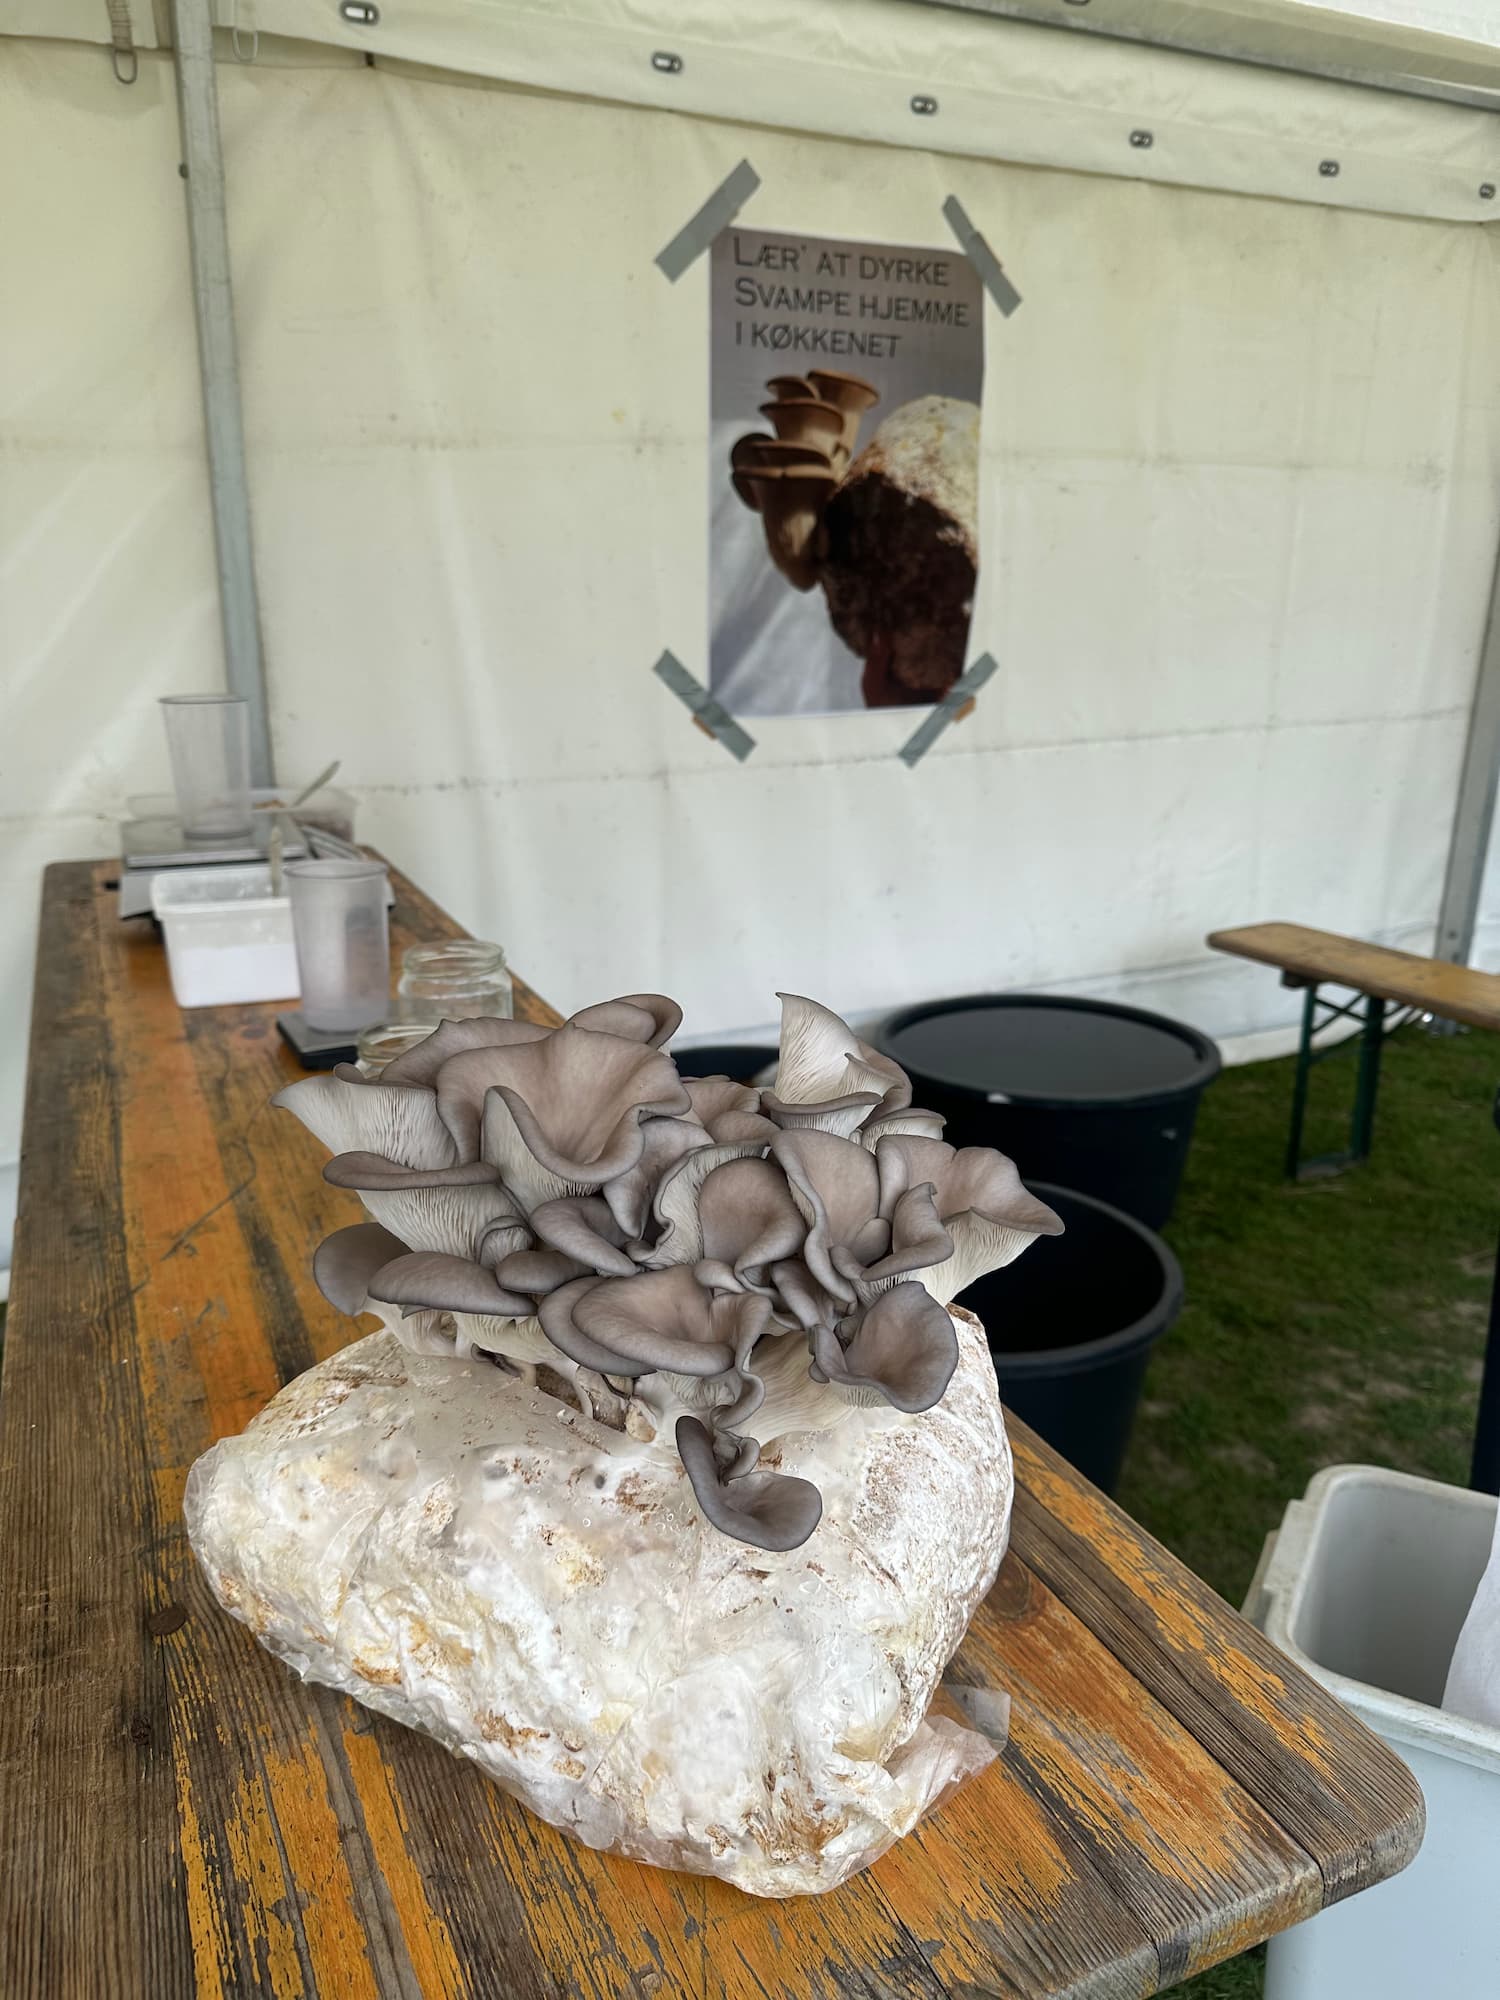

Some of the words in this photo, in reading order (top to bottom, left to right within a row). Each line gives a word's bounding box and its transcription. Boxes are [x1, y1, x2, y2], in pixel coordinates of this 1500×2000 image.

[816, 252, 851, 278] AT
[858, 256, 950, 287] DYRKE
[734, 277, 851, 317] SVAMPE
[858, 296, 970, 327] HJEMME
[735, 321, 743, 345] I
[751, 323, 902, 358] KØKKENET
